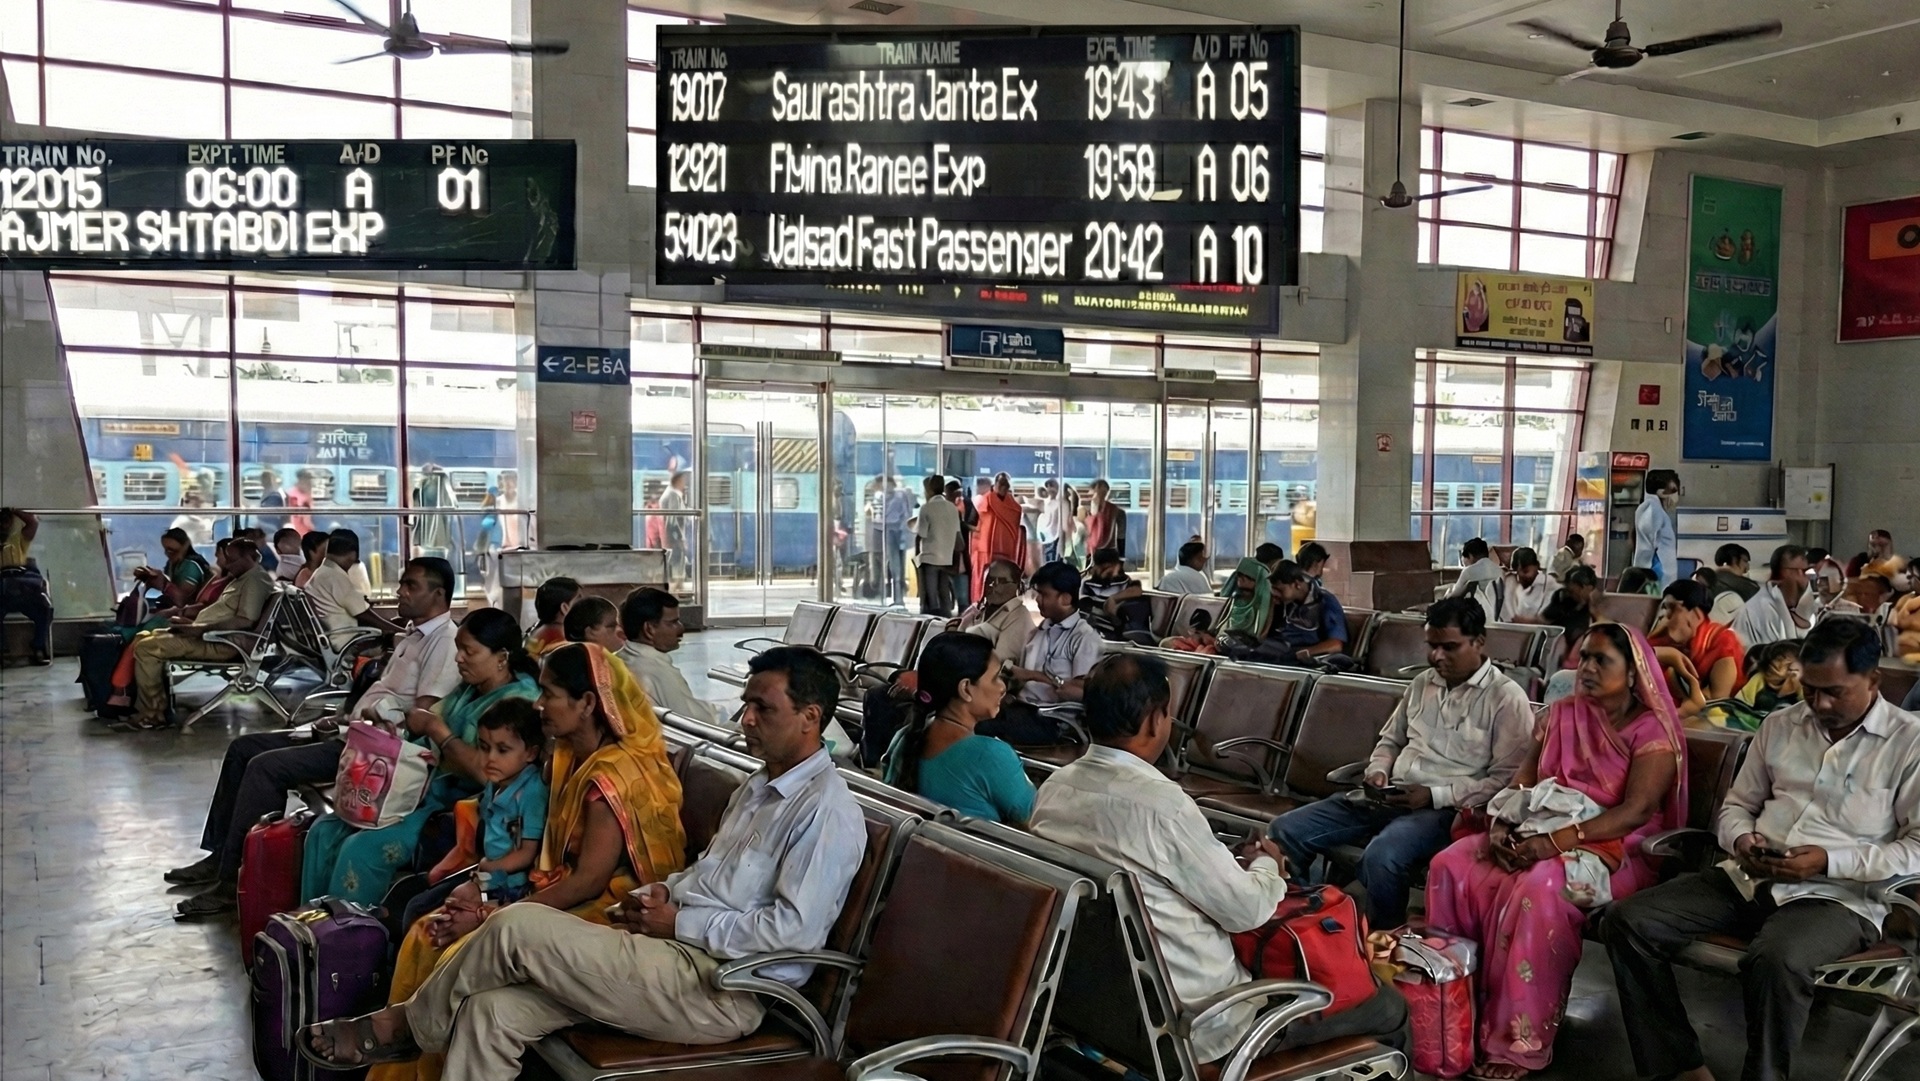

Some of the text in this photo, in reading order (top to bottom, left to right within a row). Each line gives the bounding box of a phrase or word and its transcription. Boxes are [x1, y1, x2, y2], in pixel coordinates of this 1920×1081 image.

[670, 47, 707, 69] TRAIN
[876, 42, 917, 64] TRAIN
[922, 41, 961, 63] NAME
[1124, 36, 1156, 60] TIME
[1193, 35, 1221, 60] A/D
[669, 61, 1269, 122] 19017 Saurashtra Janta Ex 19:43 A 05
[2, 145, 68, 166] TRAIN
[76, 147, 113, 167] No.
[188, 144, 237, 164] EXPT.
[241, 144, 285, 164] TIME
[339, 142, 381, 165] A/D
[431, 144, 456, 166] PF
[667, 142, 1270, 202] 12921 Flying Ranee Exp 19:58 A 06
[0, 166, 481, 210] 12015 06:00 A 01
[0, 209, 384, 253] AJMER SHTABDI EXP
[857, 215, 917, 270] Fast
[920, 216, 1073, 276] Passenger
[1085, 221, 1164, 281] 20:42
[1198, 224, 1218, 284] A
[1231, 225, 1263, 285] 10
